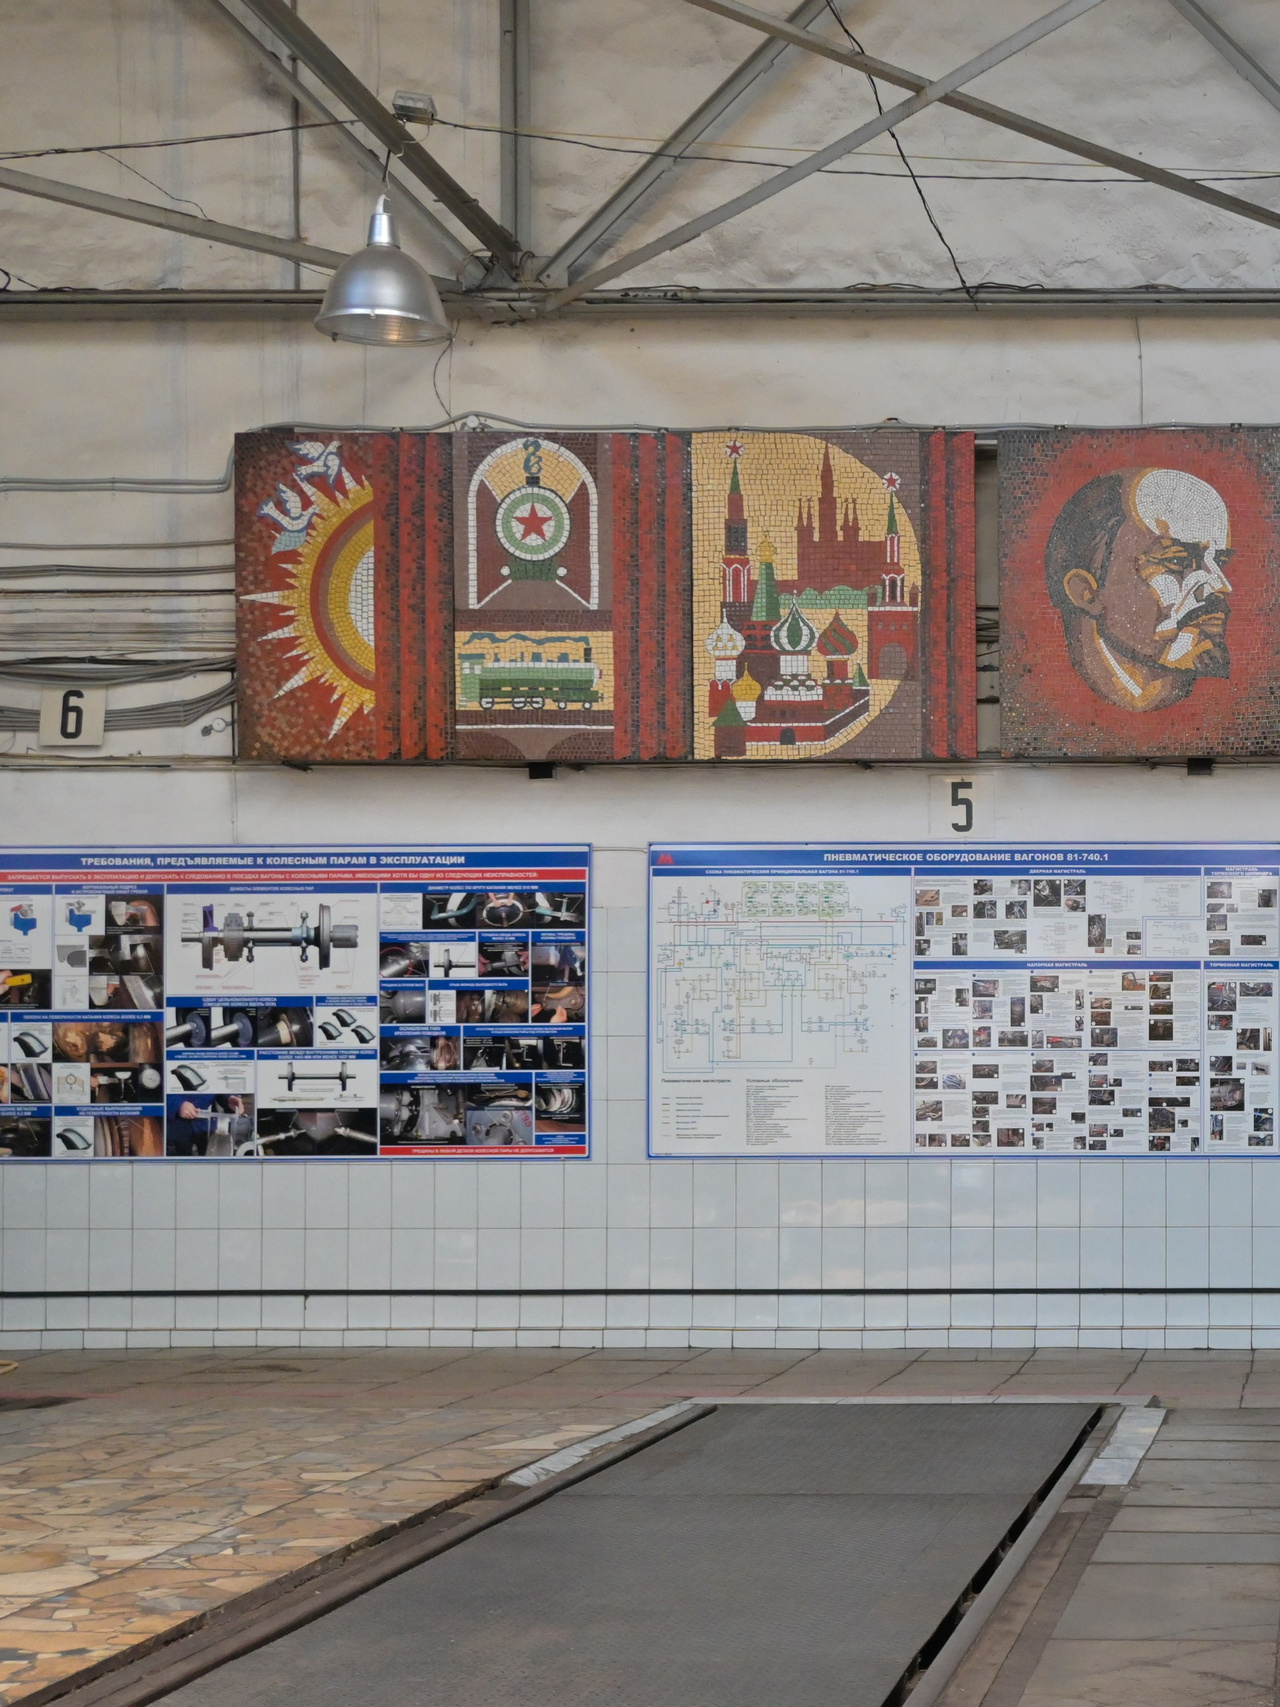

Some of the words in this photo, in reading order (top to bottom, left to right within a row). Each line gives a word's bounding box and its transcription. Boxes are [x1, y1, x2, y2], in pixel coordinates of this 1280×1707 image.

[60, 690, 84, 739] 6
[952, 782, 973, 832] 5
[81, 858, 154, 866] ТРЕБОВАНИЯ,
[157, 857, 254, 866] ПРЕДЪЯВЛЯЕМЫЕ
[266, 856, 327, 864] КОЛЕСНЫМ
[380, 856, 465, 865] ЭКСПЛУАТАЦИИ
[926, 854, 1011, 862] ОБОРУДОВАНИЕ
